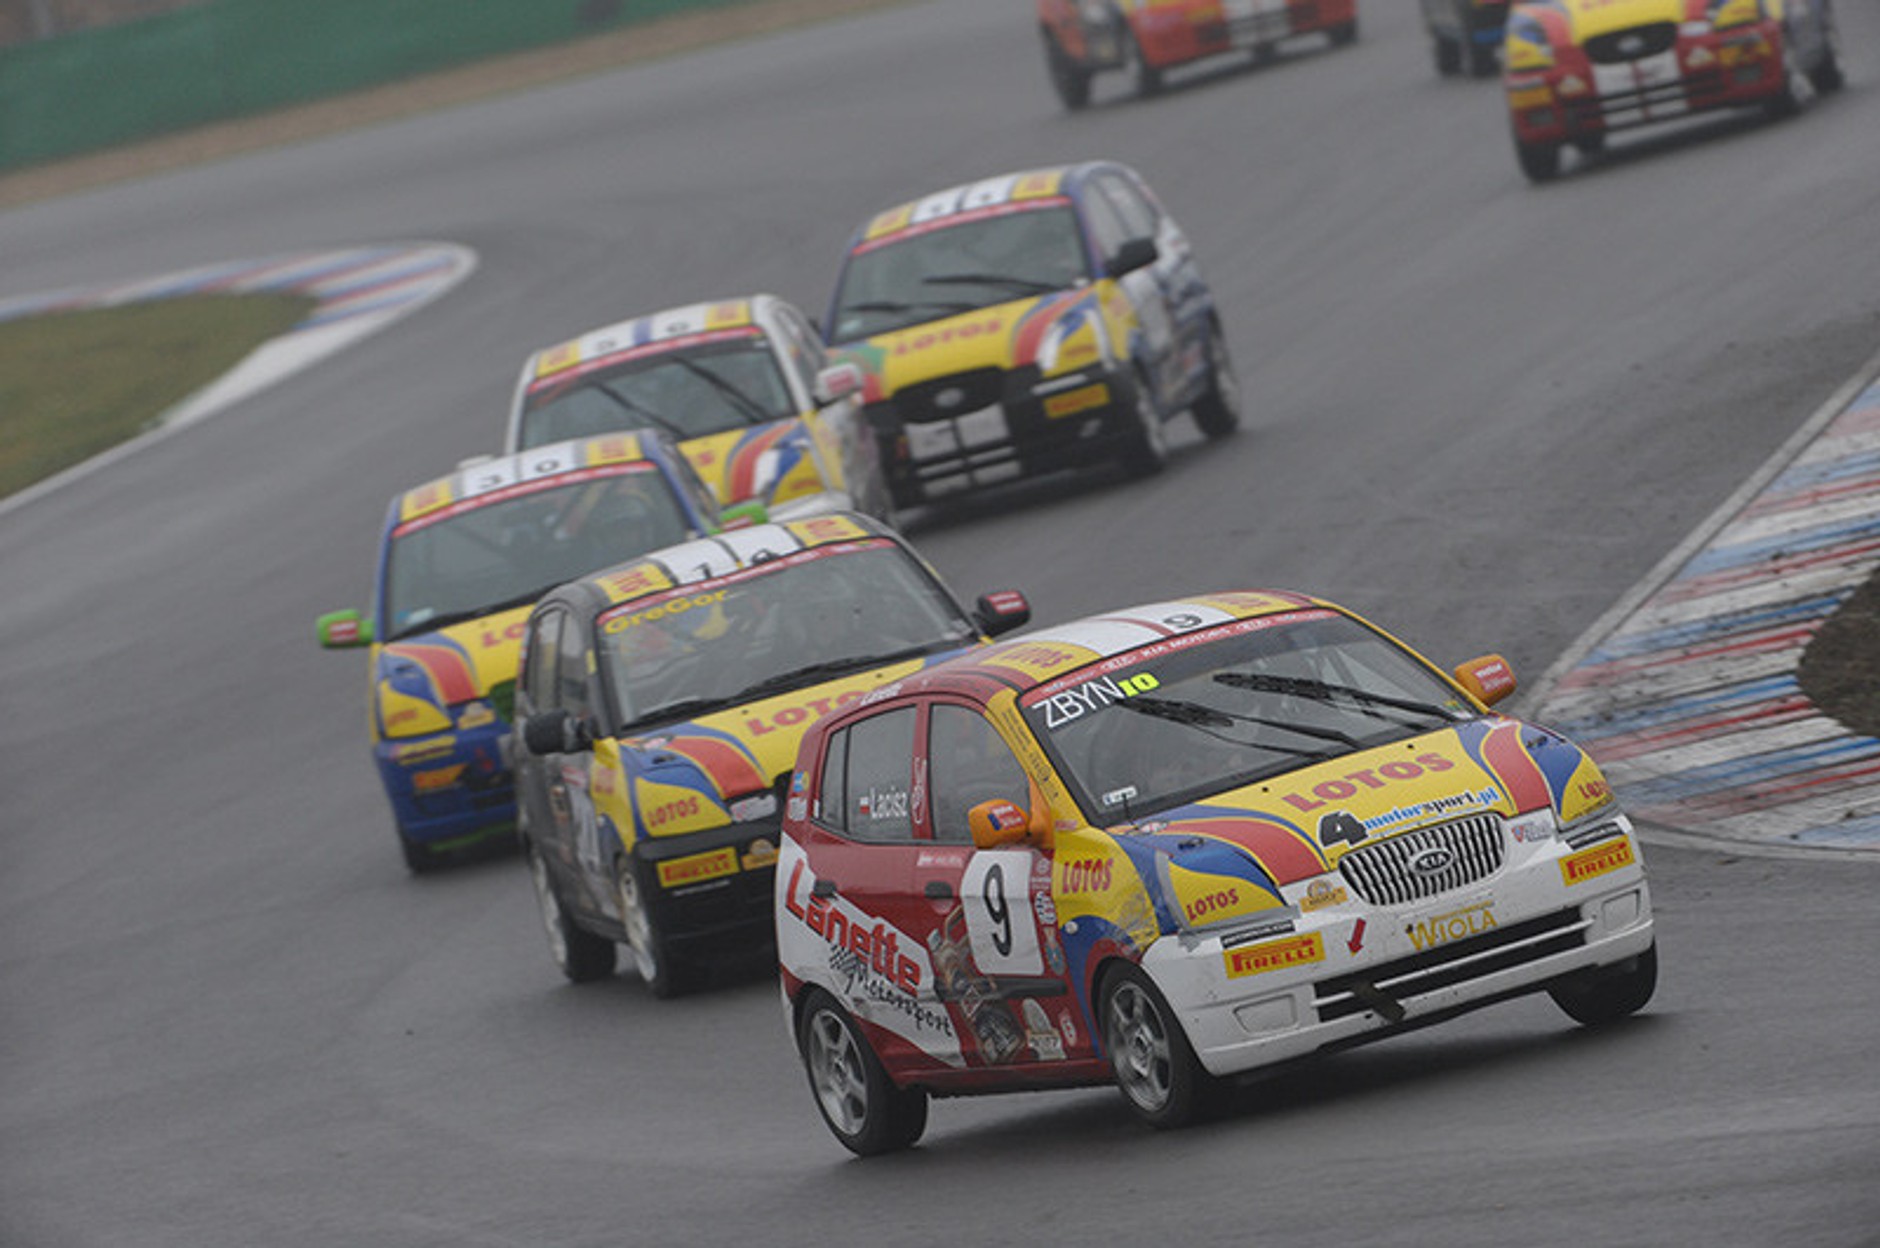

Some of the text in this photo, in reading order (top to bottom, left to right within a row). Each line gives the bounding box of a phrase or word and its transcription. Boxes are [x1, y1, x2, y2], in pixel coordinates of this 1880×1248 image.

[1282, 751, 1455, 812] LOTOS
[647, 796, 700, 828] LOTOS
[1061, 857, 1115, 894] LOTOS
[1419, 852, 1448, 869] KIA
[1566, 841, 1631, 880] PIRELLI
[983, 862, 1013, 958] 9
[1186, 887, 1240, 922] LOTOS
[1405, 908, 1498, 951] WIOLA
[1231, 937, 1315, 973] PIRELLI
